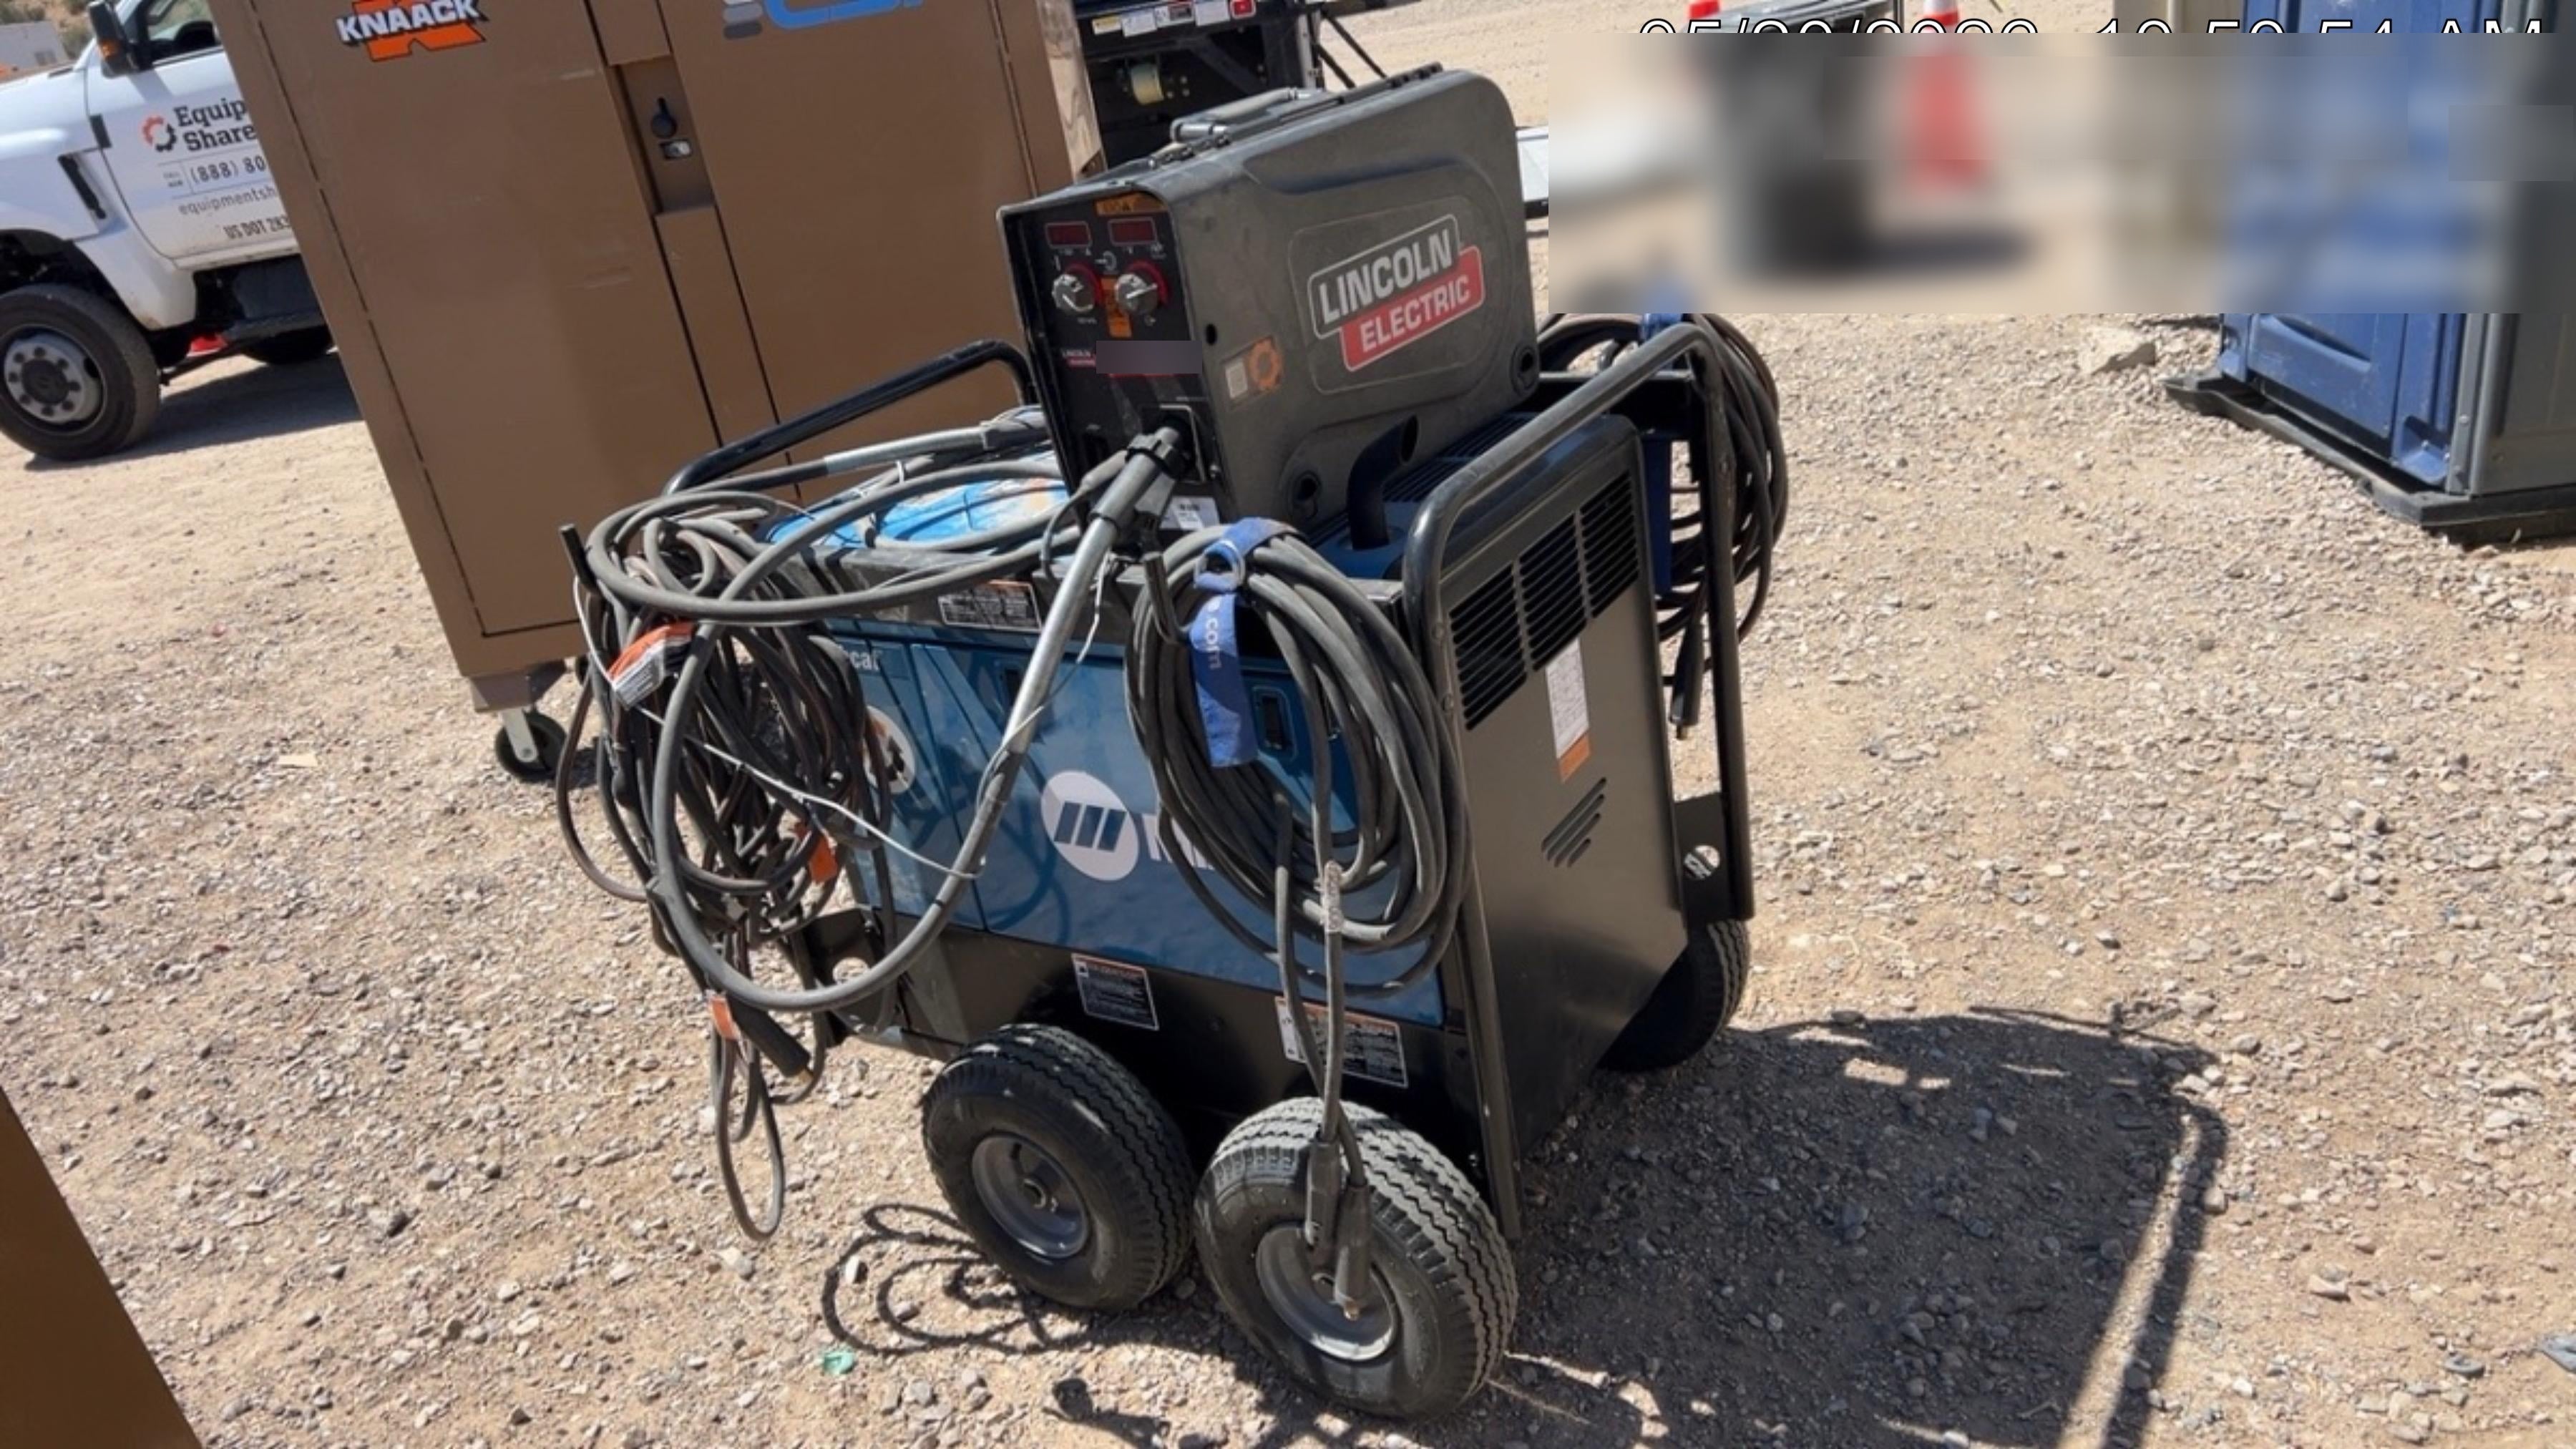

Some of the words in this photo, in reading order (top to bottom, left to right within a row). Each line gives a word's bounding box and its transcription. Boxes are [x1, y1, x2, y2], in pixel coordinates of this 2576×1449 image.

[336, 0, 481, 43] KNAACK
[173, 97, 247, 127] Equip
[182, 125, 259, 152] Share
[190, 160, 238, 184] (888)
[1319, 228, 1453, 325] LINCOLN
[1360, 274, 1471, 352] ELECTRIC
